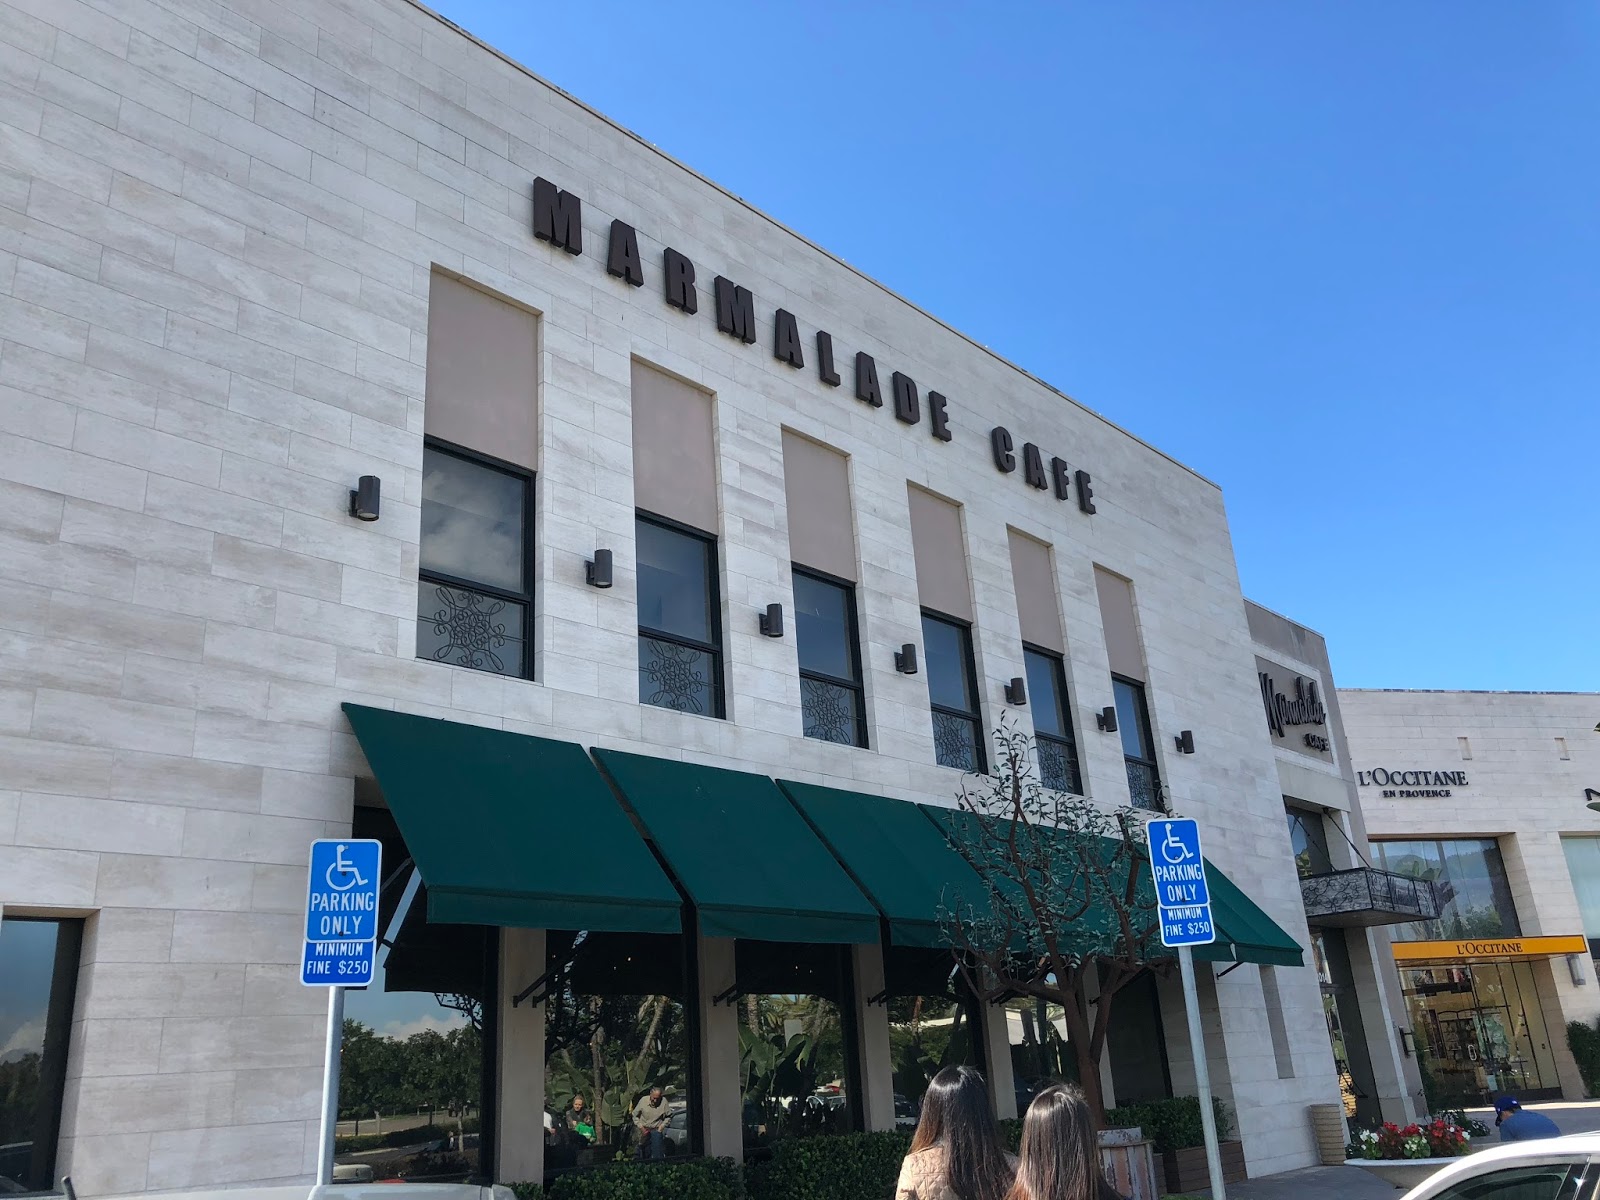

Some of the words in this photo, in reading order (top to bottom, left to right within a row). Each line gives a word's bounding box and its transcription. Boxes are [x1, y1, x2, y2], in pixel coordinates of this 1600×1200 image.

[533, 176, 952, 442] MARMALADE
[991, 426, 1096, 515] CAFE
[1304, 733, 1329, 752] CAFE
[1383, 790, 1396, 798] EN
[1399, 790, 1452, 798] PROVENCE
[1155, 864, 1202, 882] PARKING
[310, 892, 374, 911] PARKING
[1167, 884, 1197, 902] ONLY
[1168, 907, 1203, 921] MINIMUM
[320, 915, 362, 935] ONLY
[1165, 924, 1183, 937] FINE
[1188, 922, 1210, 936] $250
[315, 943, 364, 956] MINIMUM
[306, 961, 331, 974] FINE
[337, 960, 369, 975] $250
